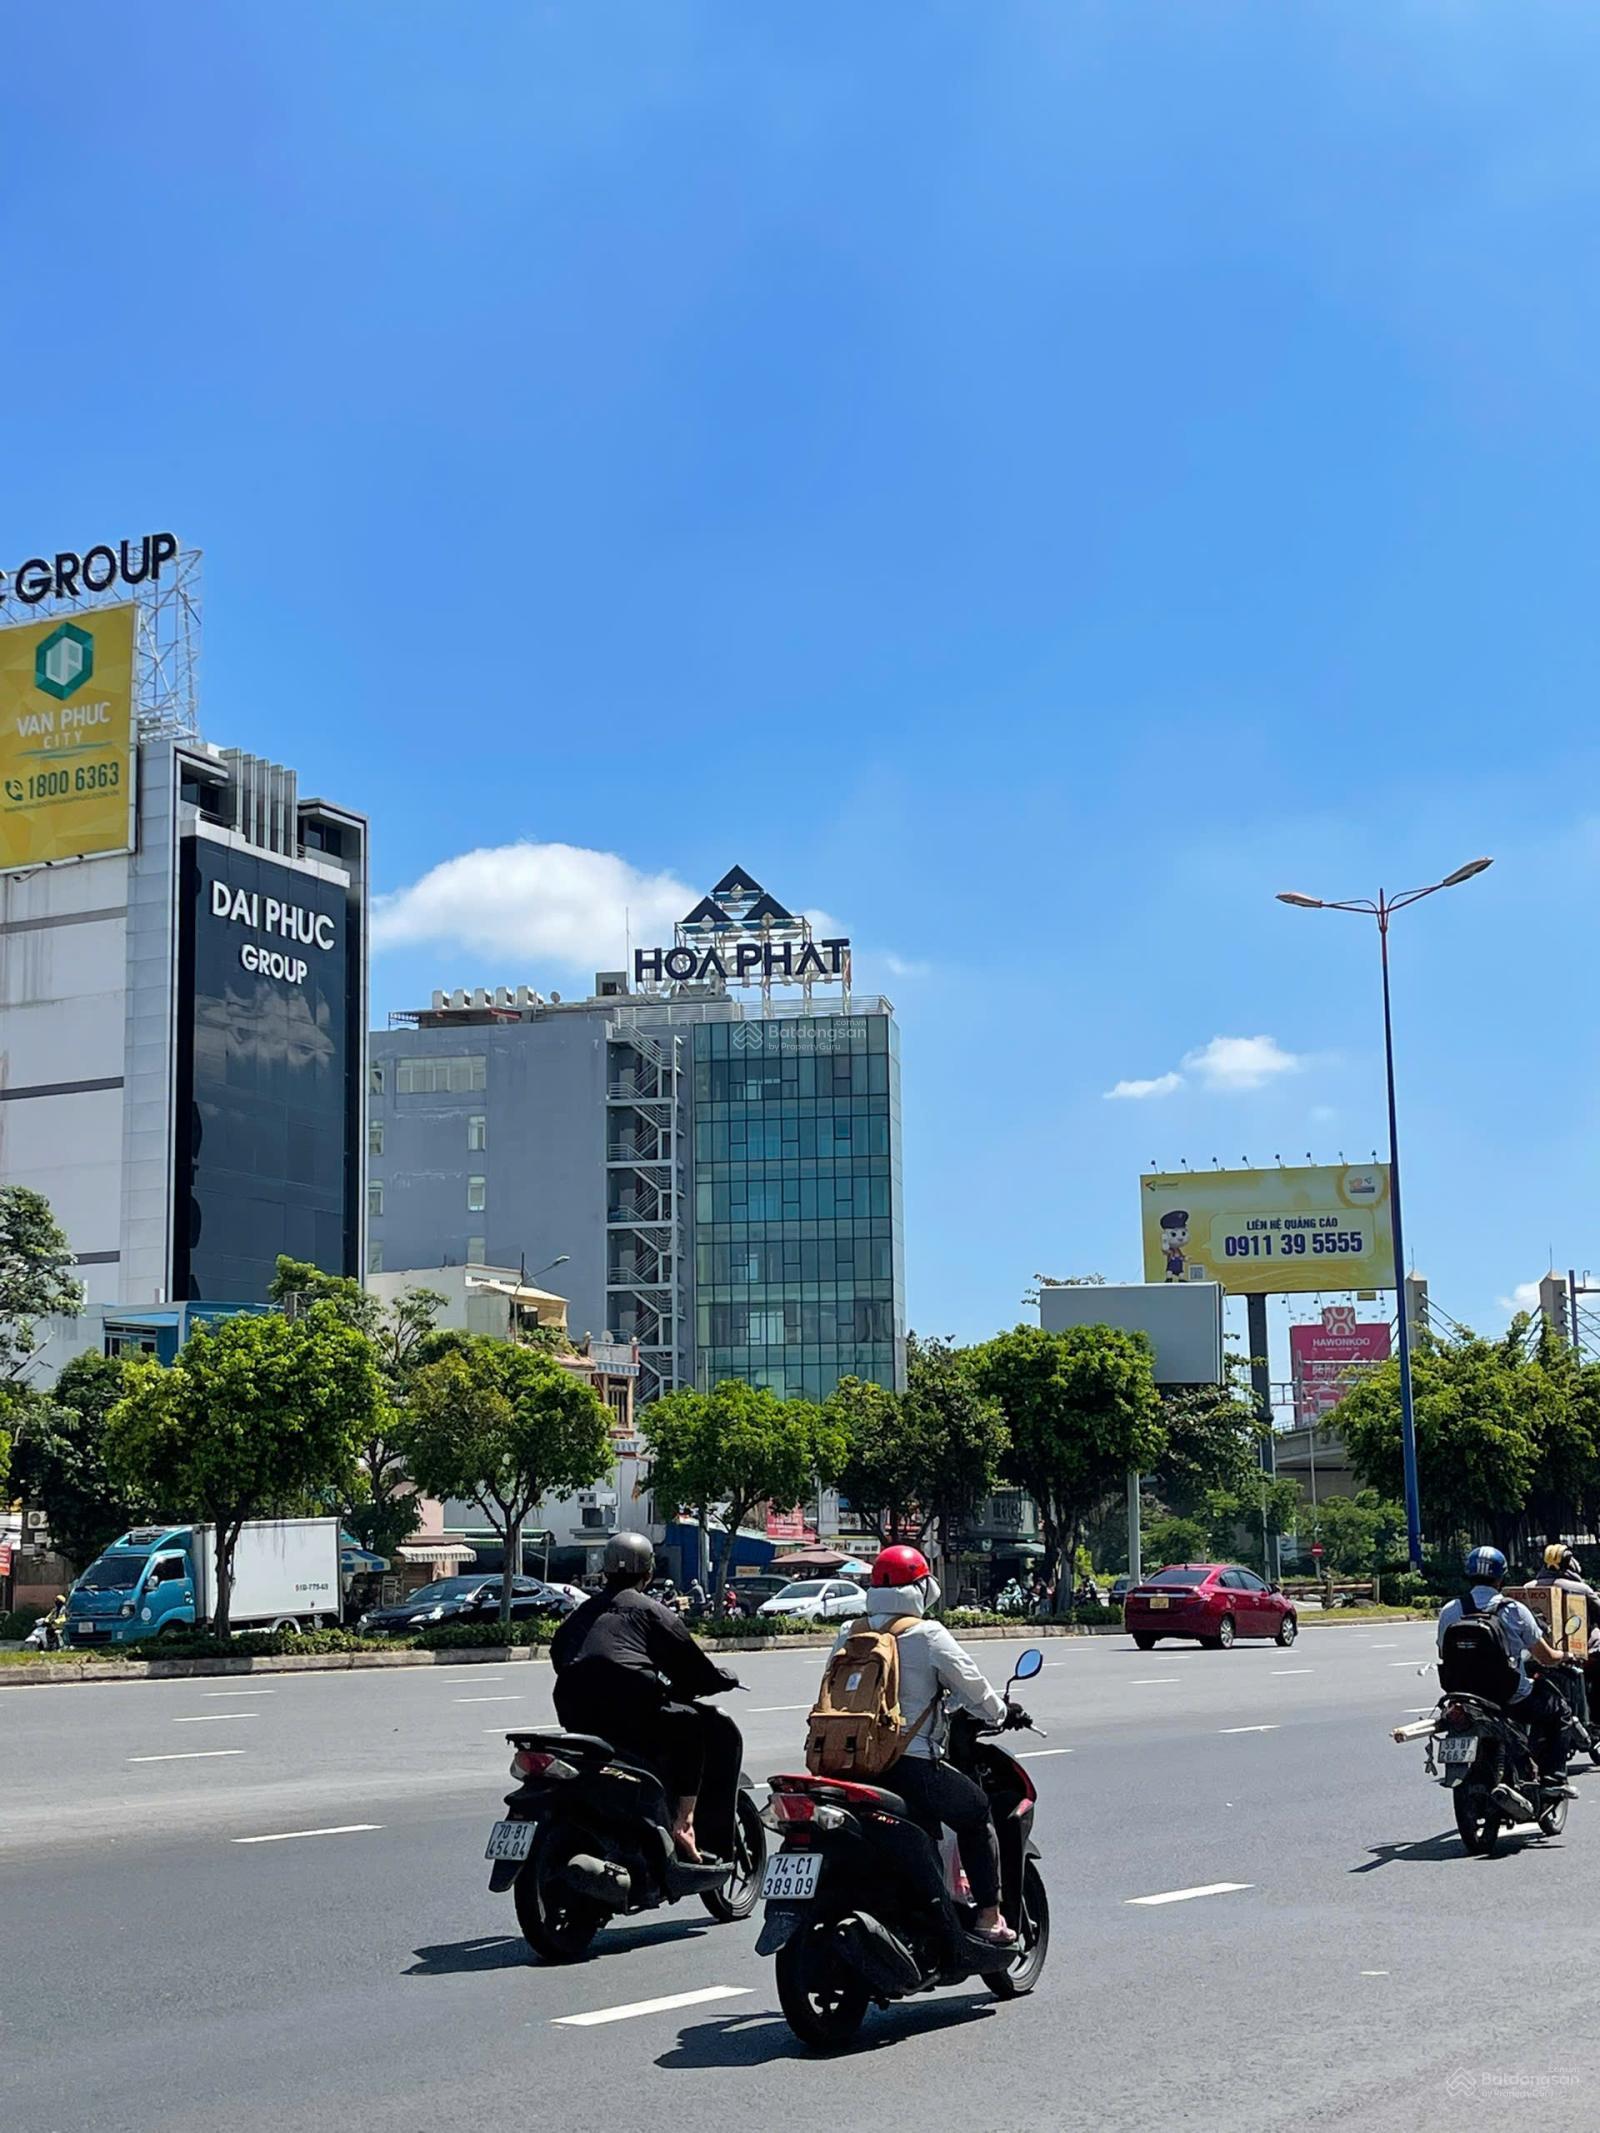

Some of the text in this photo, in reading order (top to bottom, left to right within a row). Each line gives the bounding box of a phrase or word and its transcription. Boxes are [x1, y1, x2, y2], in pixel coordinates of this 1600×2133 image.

[15, 532, 179, 604] GROUP
[17, 701, 111, 737] VAN PHUC
[44, 730, 82, 749] CITY
[28, 762, 119, 799] 1800 6363
[212, 879, 335, 951] DAI PHUC
[241, 943, 308, 985] GROUP
[1225, 1231, 1362, 1257] 0911 39 5555
[1312, 1338, 1370, 1346] HAWONKOO
[775, 1857, 812, 1875] 74-C1
[763, 1877, 813, 1896] 389.09
